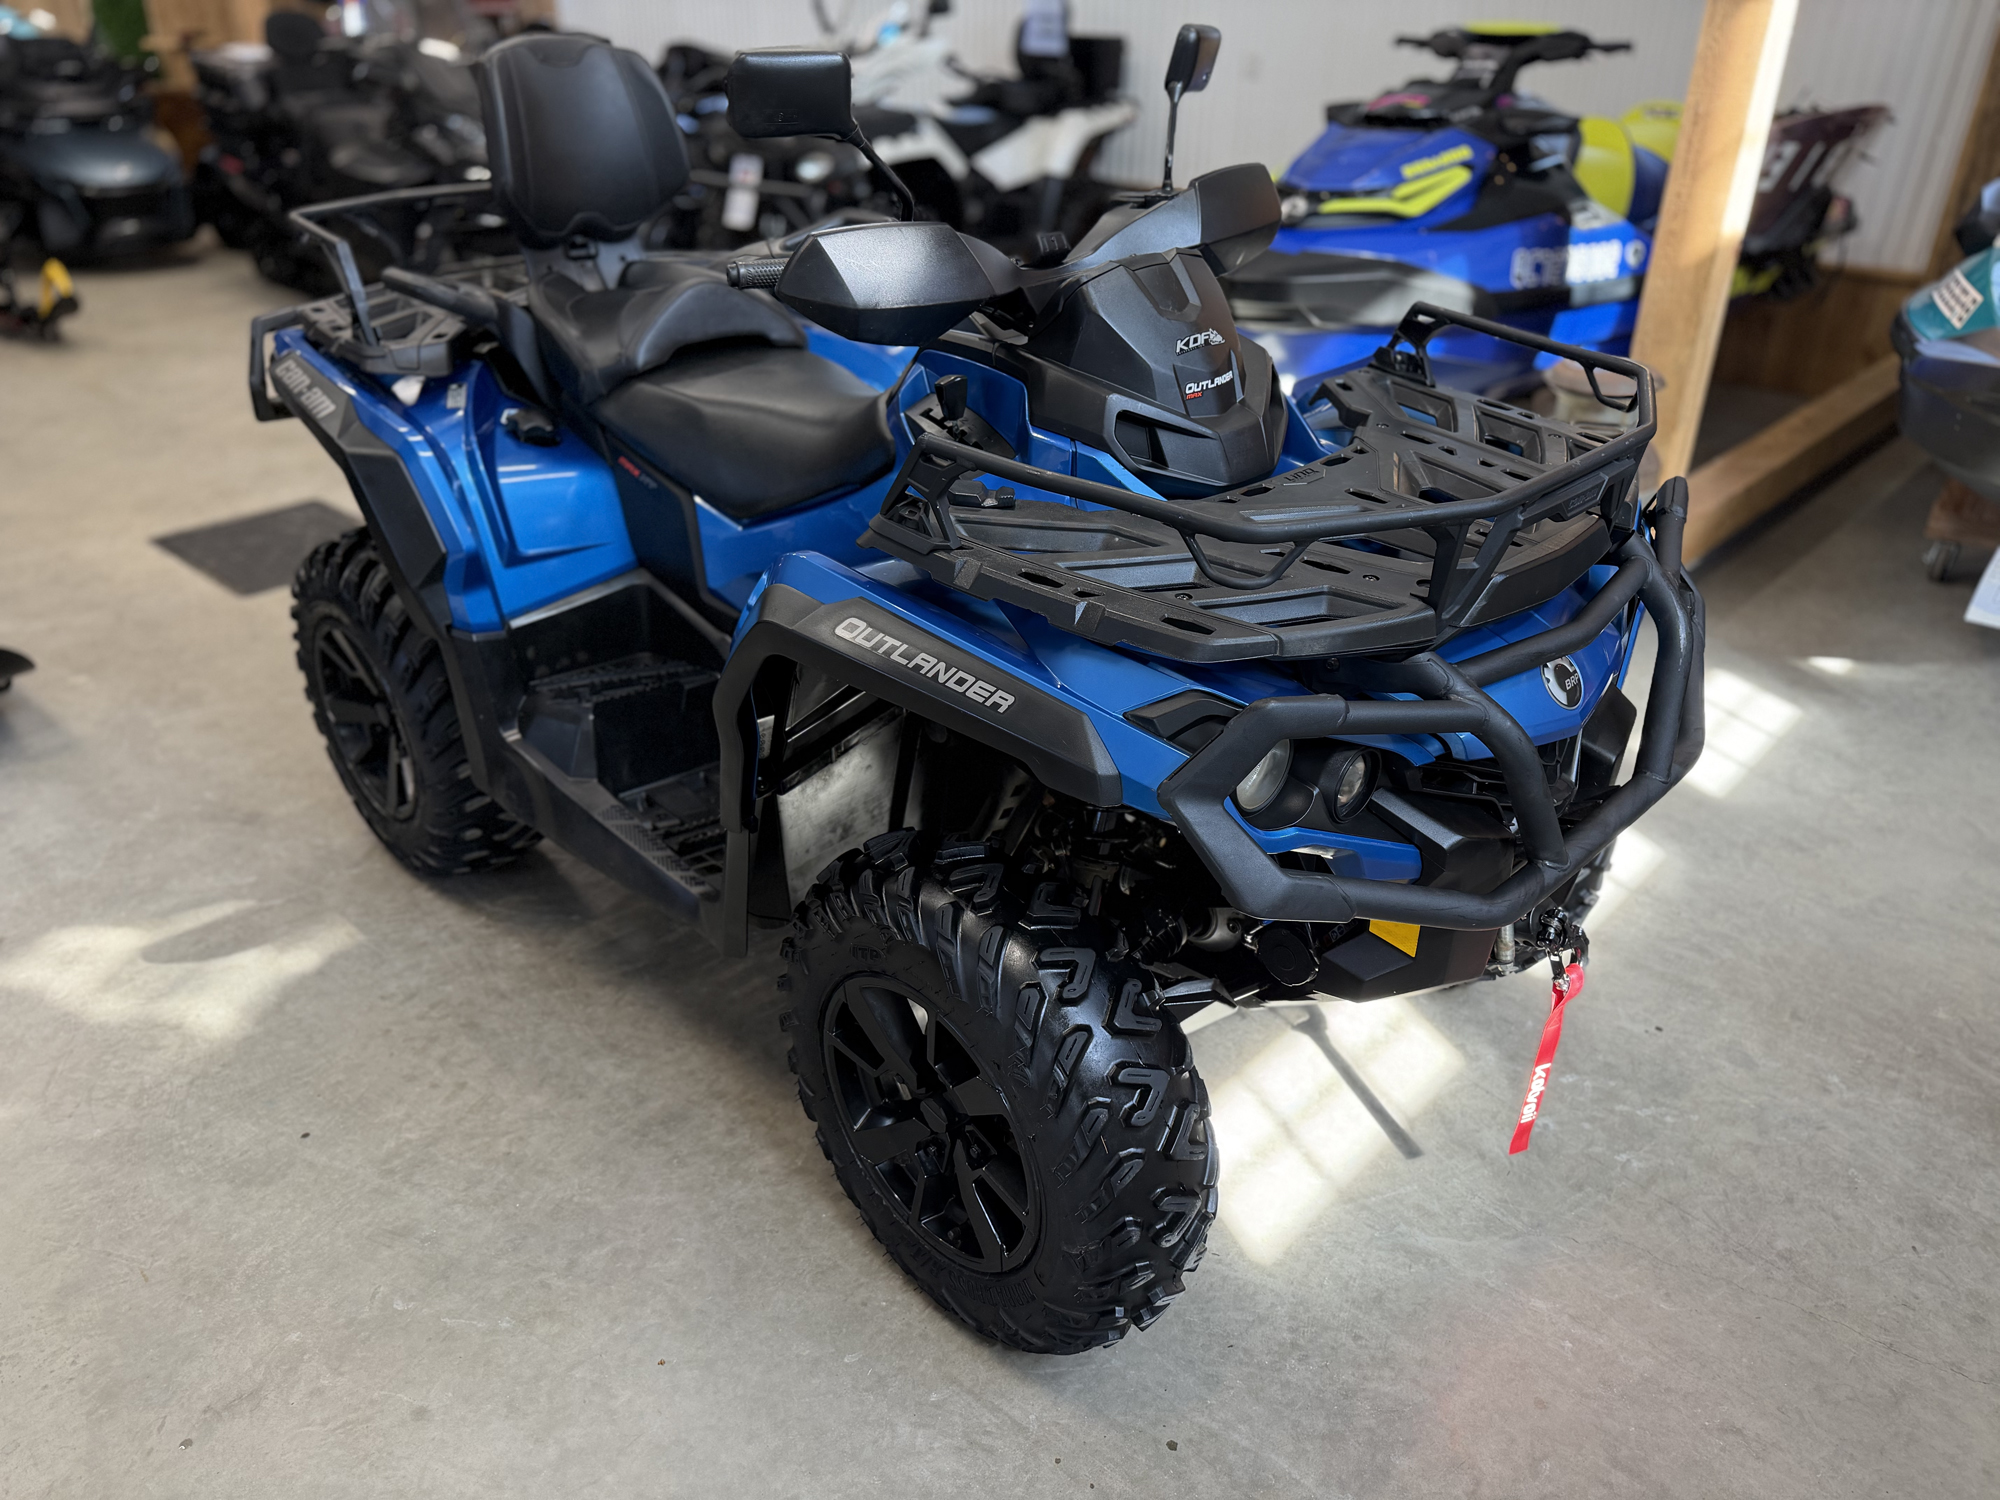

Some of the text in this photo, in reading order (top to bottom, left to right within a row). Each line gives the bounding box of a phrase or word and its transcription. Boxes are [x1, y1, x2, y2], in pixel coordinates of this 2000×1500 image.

[1185, 370, 1234, 395] OUTLANDER
[834, 617, 1016, 714] OUTLANDER
[1564, 672, 1580, 691] BRP
